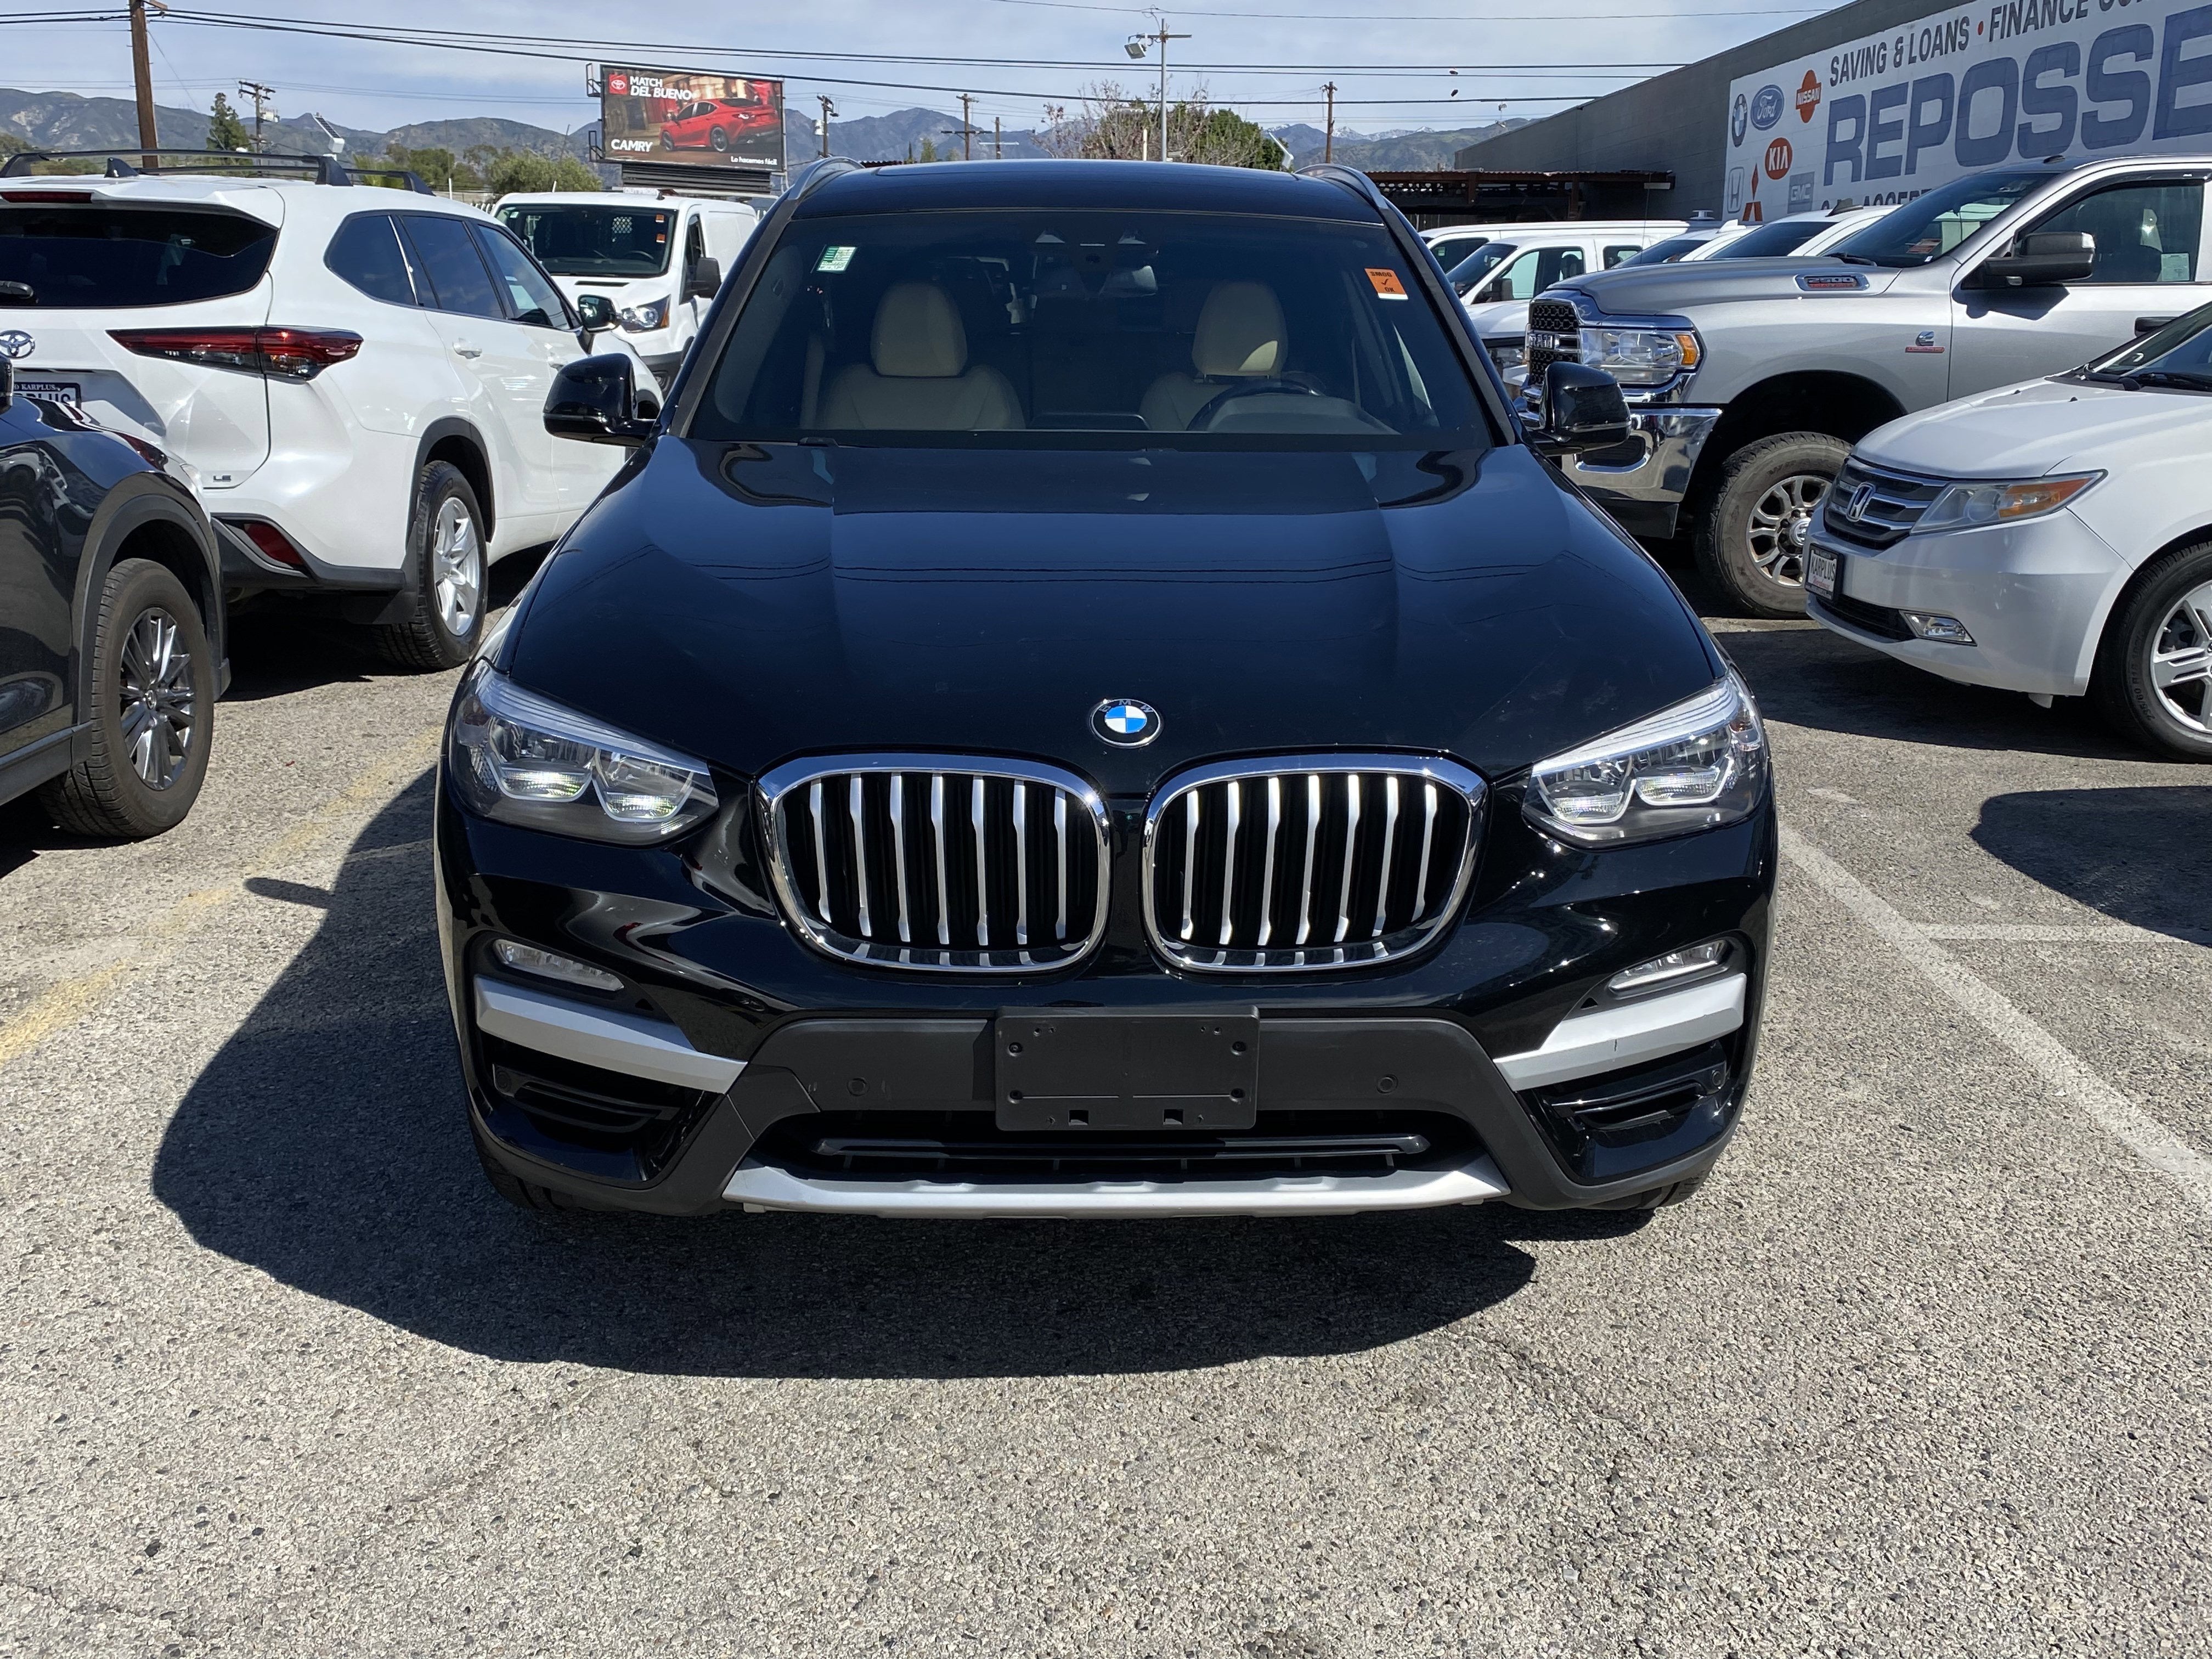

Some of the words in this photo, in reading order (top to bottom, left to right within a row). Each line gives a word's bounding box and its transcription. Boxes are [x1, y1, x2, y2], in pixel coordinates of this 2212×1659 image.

[1830, 42, 1887, 87] SAVING
[1893, 36, 1904, 68] &
[1908, 16, 1970, 65] LOANS
[629, 76, 663, 88] MATCH
[630, 87, 651, 97] DEL
[653, 88, 692, 100] BUENO
[1797, 86, 1821, 105] NISSAN
[1822, 4, 2212, 186] REPOSSE
[1757, 95, 1778, 120] Ford
[611, 139, 652, 153] CAMRY
[1768, 145, 1788, 171] KIA
[1791, 183, 1811, 201] GMC
[1810, 555, 1836, 582] KARPLUS
[1098, 699, 1154, 713] BMW
